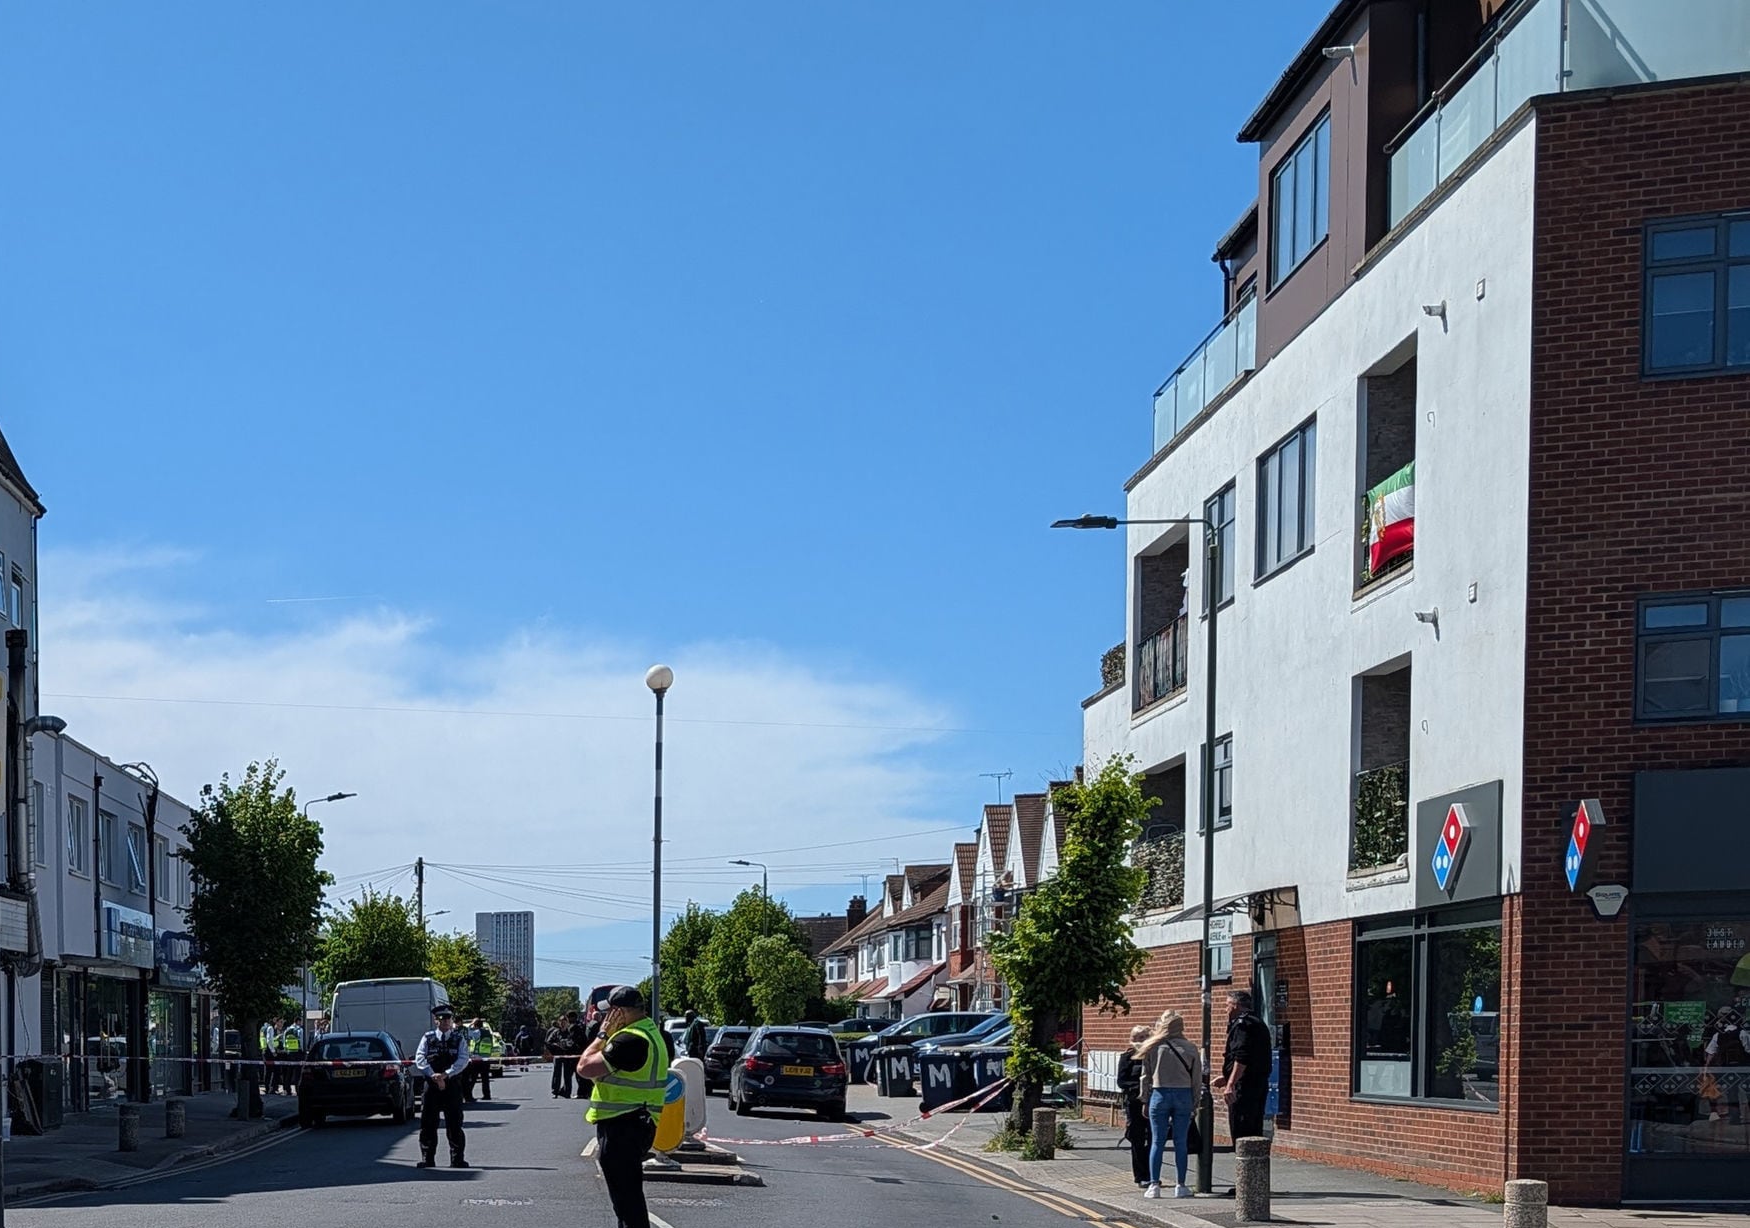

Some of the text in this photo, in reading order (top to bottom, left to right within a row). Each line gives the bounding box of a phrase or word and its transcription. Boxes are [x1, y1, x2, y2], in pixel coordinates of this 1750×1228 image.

[1706, 927, 1733, 938] JUST
[1706, 938, 1746, 950] LANDED
[855, 1047, 870, 1064] M
[891, 1056, 911, 1081] M
[928, 1063, 952, 1088] M
